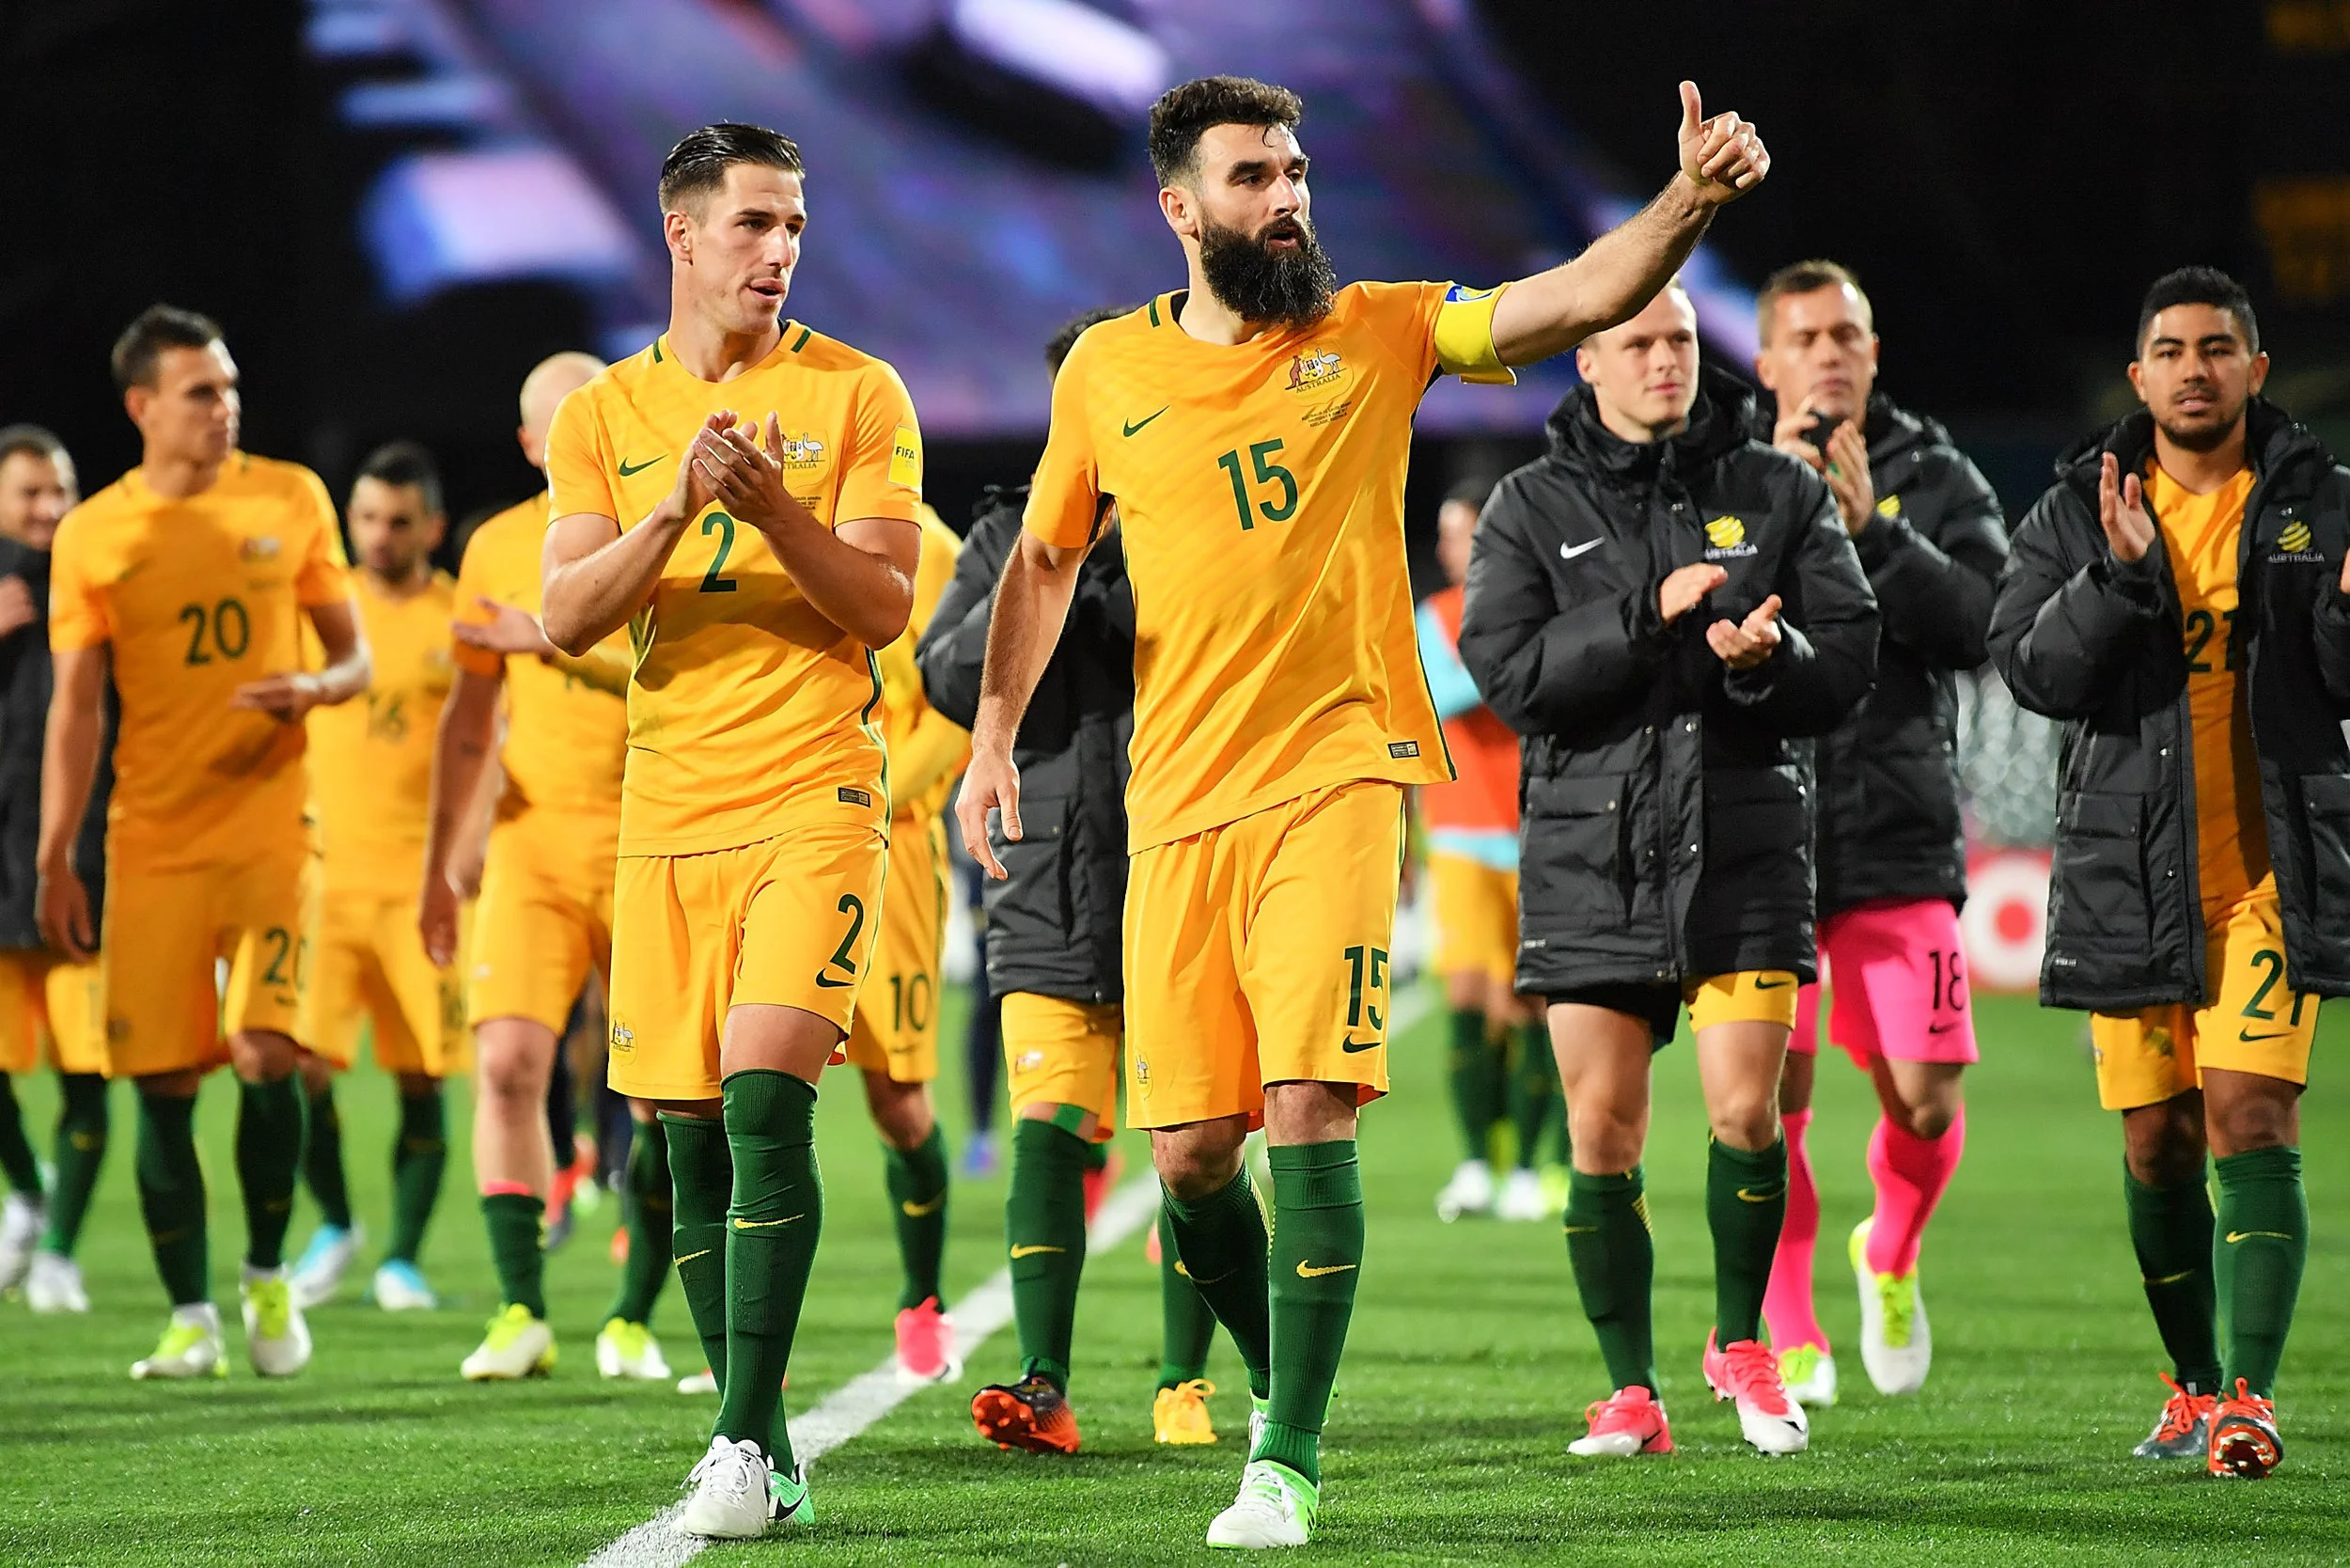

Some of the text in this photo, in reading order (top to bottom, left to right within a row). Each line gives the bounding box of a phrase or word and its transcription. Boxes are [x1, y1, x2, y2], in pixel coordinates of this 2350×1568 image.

[1295, 374, 1341, 393] AUSTRALIA
[784, 462, 817, 470] TRALIA
[895, 446, 915, 460] FIFA
[1217, 438, 1297, 530] 15
[699, 511, 737, 593] 2
[1704, 543, 1758, 559] USTRALIA
[2267, 552, 2326, 563] AUSTRALIA
[178, 597, 250, 666] 20
[2186, 609, 2239, 672] 21
[829, 893, 864, 975] 2
[890, 973, 931, 1032] 10
[1344, 946, 1388, 1030] 15
[1928, 950, 1965, 1011] 18
